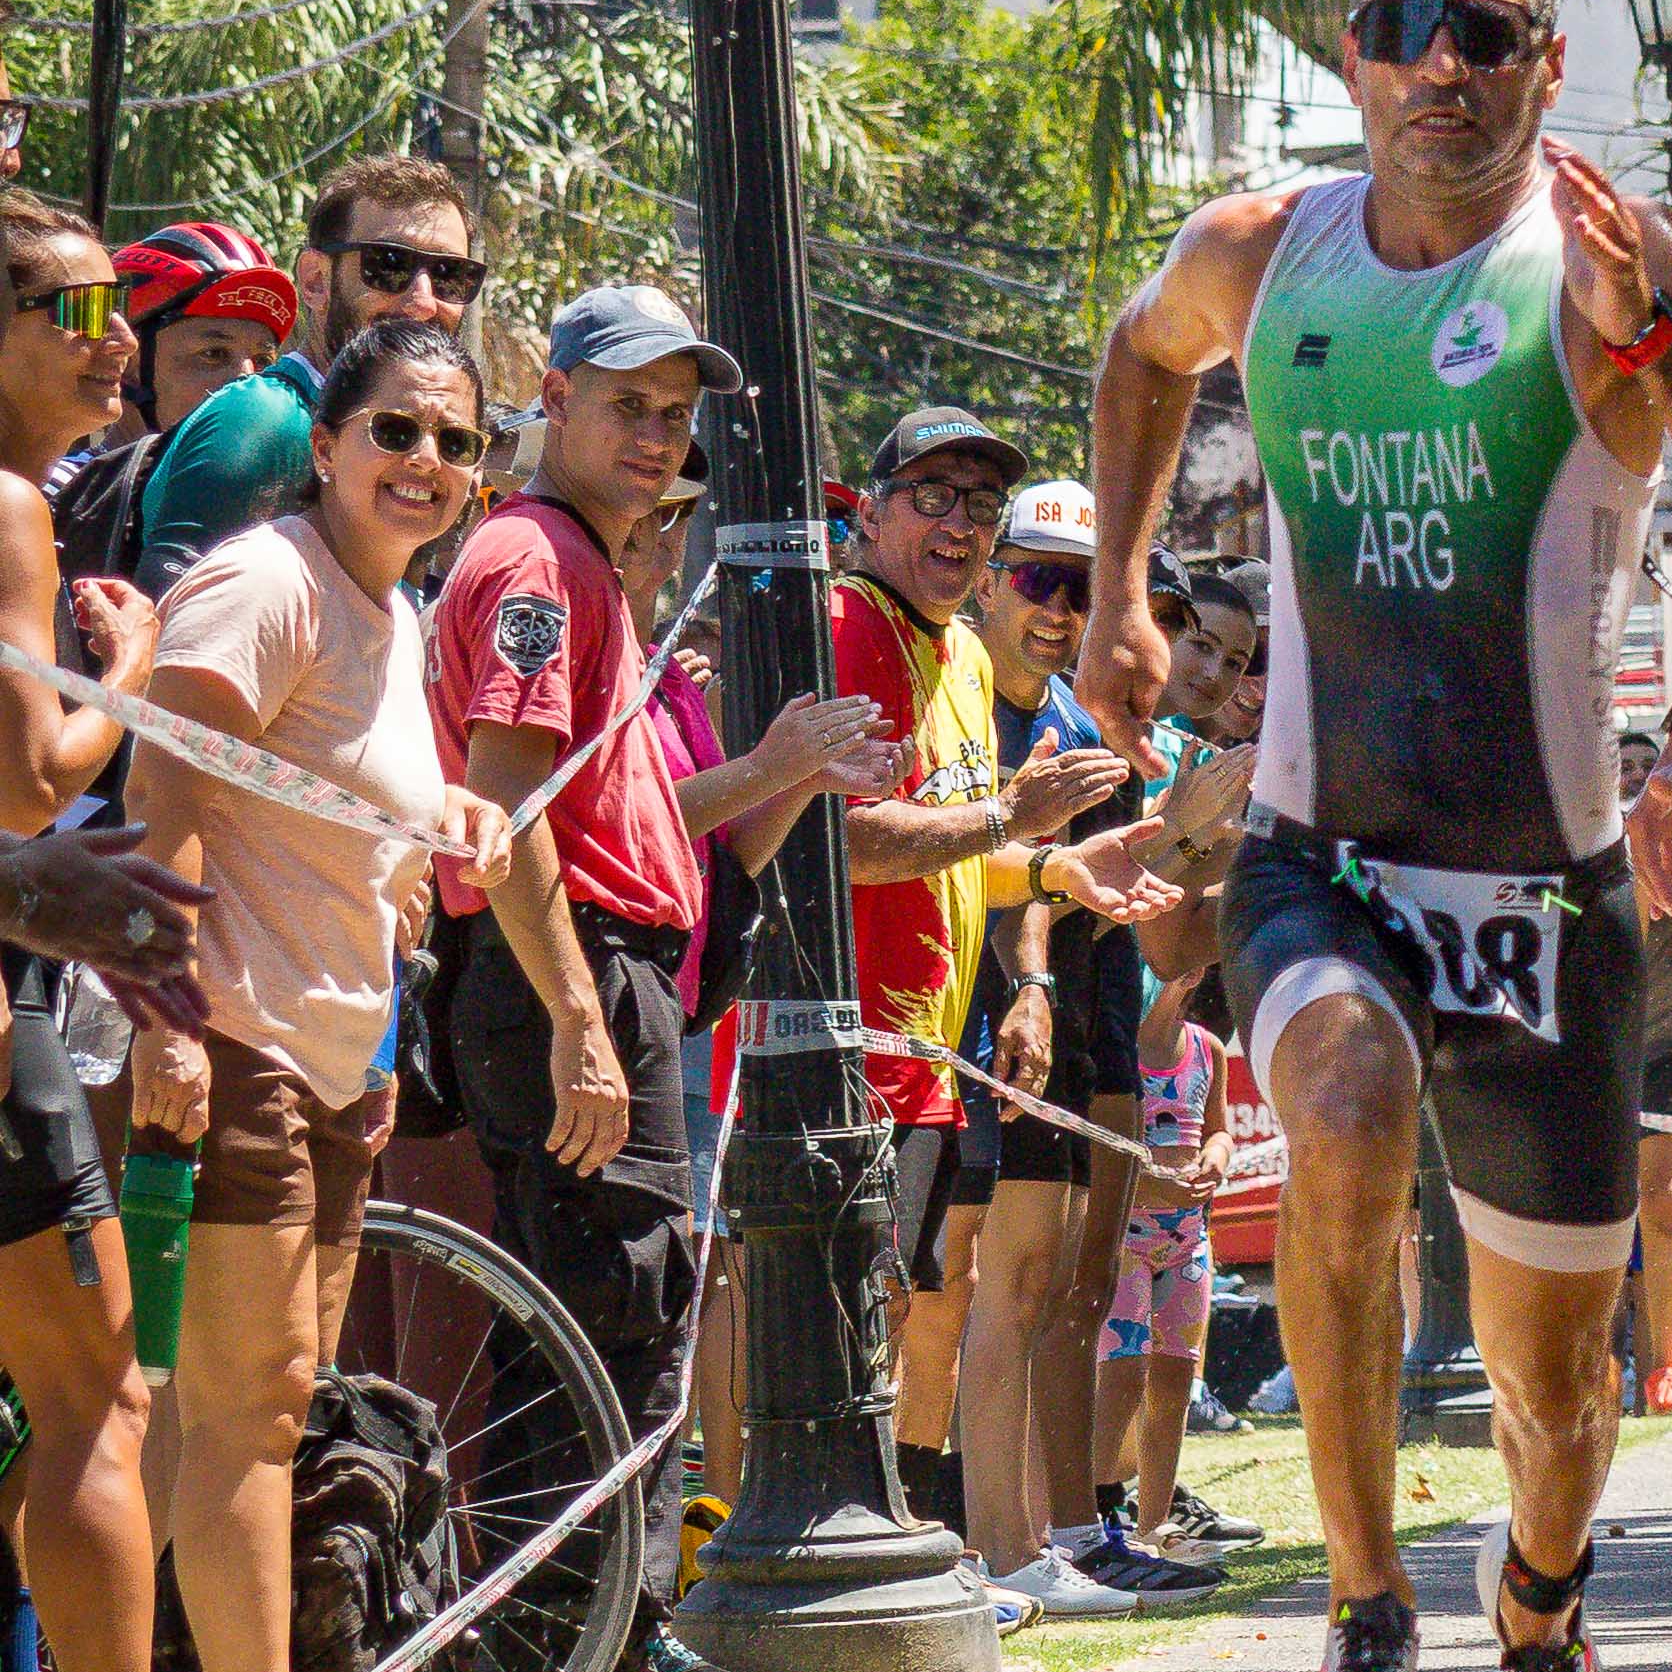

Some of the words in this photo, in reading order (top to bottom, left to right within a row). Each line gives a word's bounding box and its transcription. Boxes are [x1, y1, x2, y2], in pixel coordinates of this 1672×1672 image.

[1300, 421, 1495, 508] FONTANA
[1034, 501, 1062, 523] ISA
[1353, 509, 1456, 593] ARG
